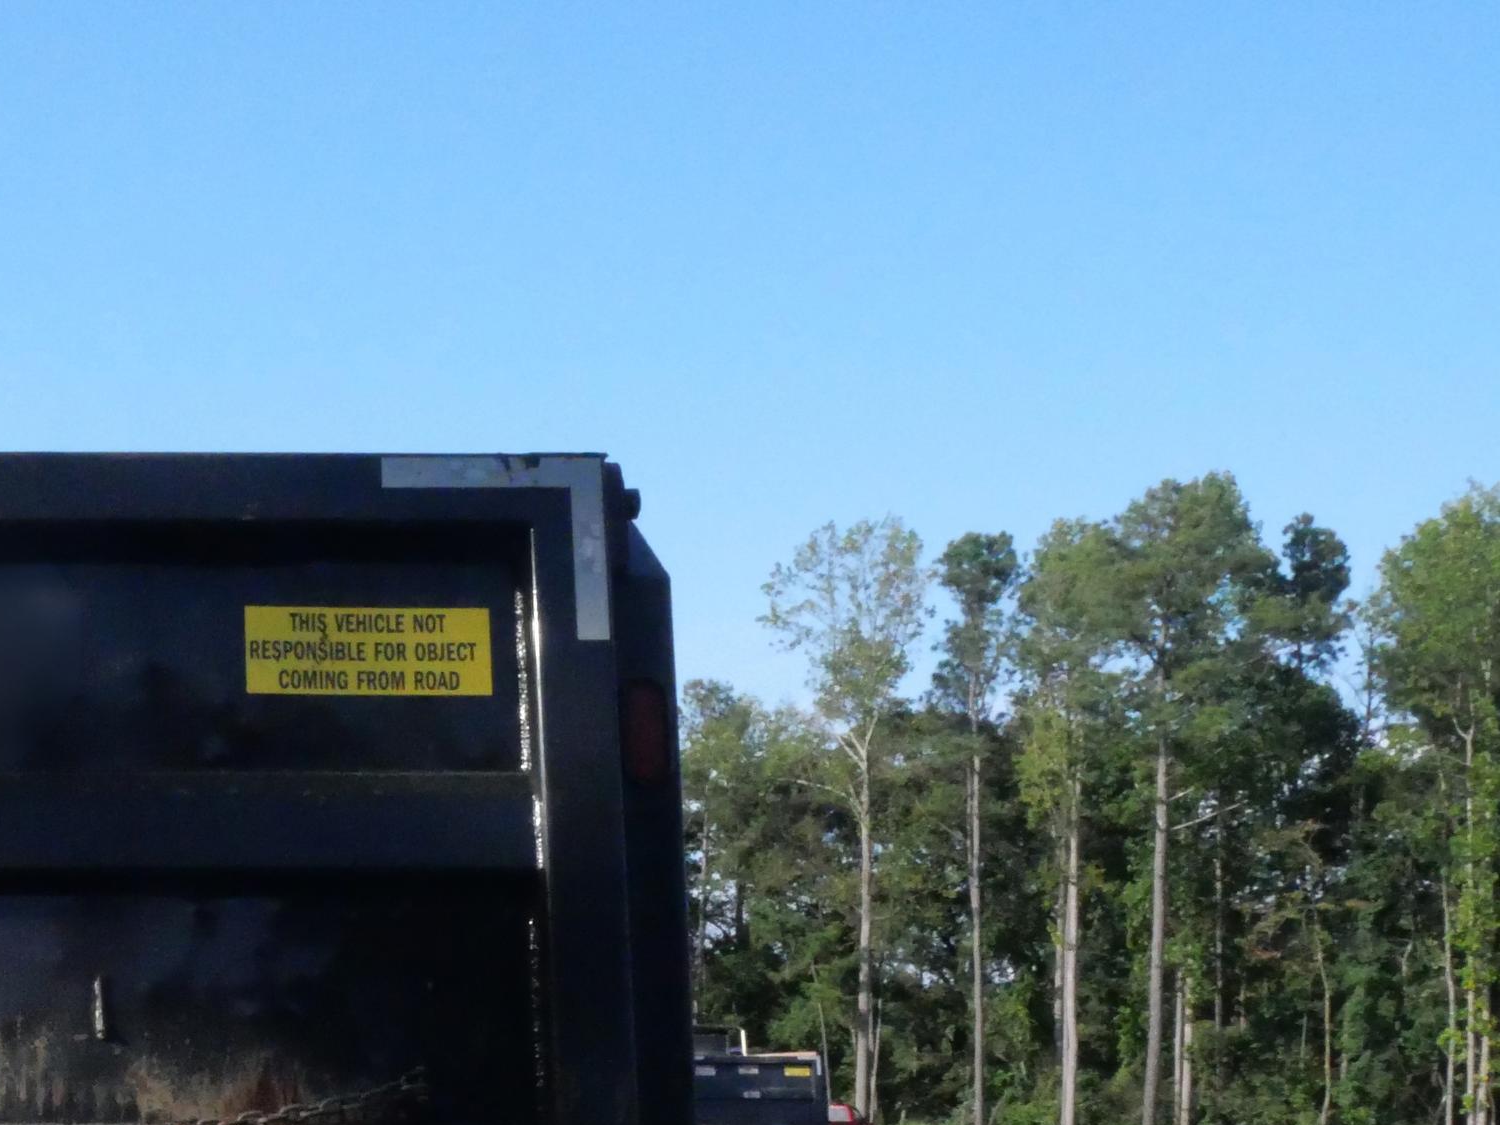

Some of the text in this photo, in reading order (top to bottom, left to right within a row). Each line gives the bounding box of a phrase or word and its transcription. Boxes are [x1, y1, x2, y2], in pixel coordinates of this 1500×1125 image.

[289, 612, 446, 633] THIS VEHICLE NOT
[250, 640, 476, 661] RESPONSIBLE FOR OBJECT
[278, 669, 460, 690] COMING FROM ROAD
